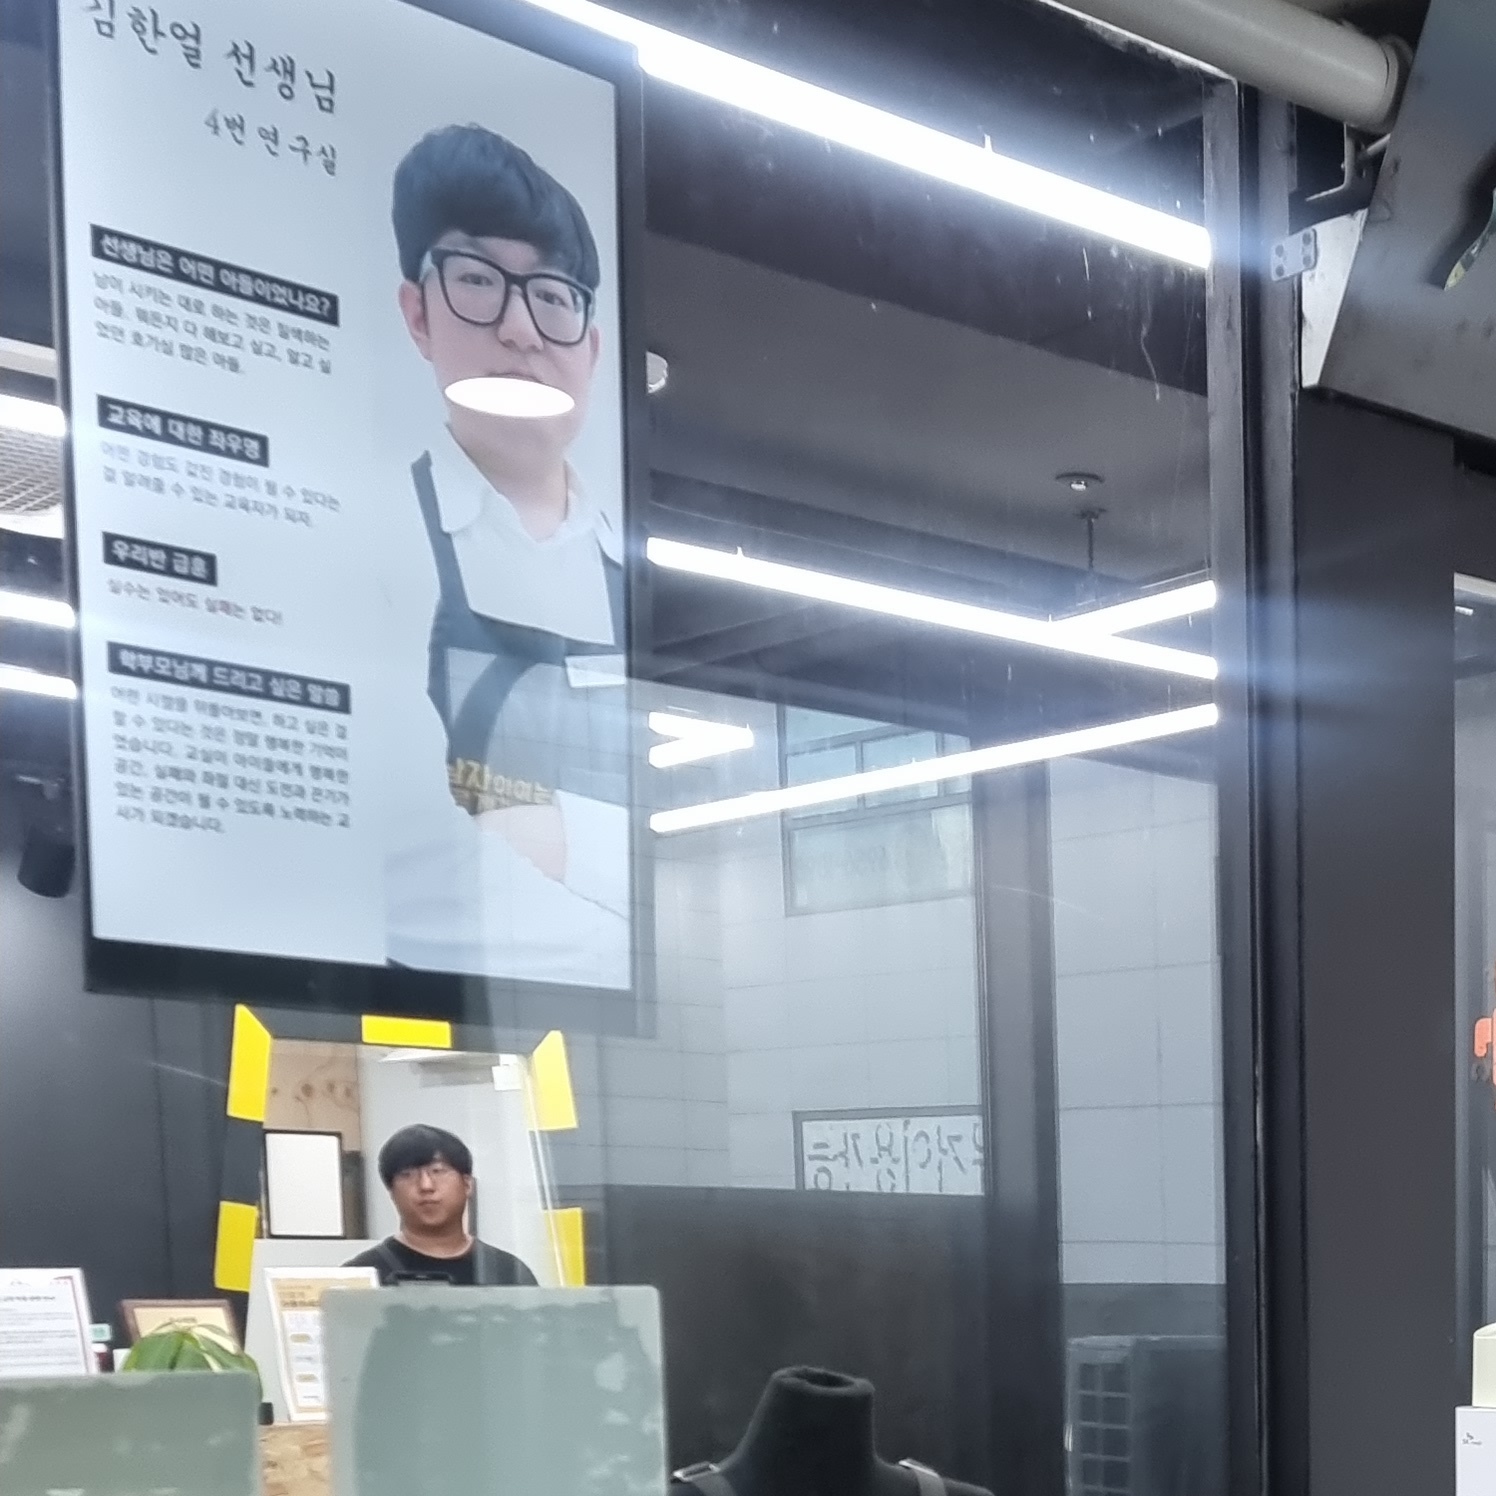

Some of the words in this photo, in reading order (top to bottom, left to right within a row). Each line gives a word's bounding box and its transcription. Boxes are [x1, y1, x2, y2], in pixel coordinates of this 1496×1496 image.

[224, 39, 336, 114] 선생님
[204, 108, 246, 146] 4번
[256, 124, 337, 177] 연구실
[101, 233, 175, 274] 선생님은
[178, 255, 215, 287] 어떤
[219, 267, 331, 317] 아들이었나요?
[107, 403, 162, 436] 교육에
[167, 417, 205, 446] 대한
[208, 428, 261, 459] 좌우명
[111, 539, 168, 571] 우리반
[172, 551, 208, 580] 급훈
[118, 648, 209, 684] 학부모님께
[212, 665, 265, 693] 드리고
[267, 675, 304, 701] 싶은
[306, 682, 341, 708] 말씀
